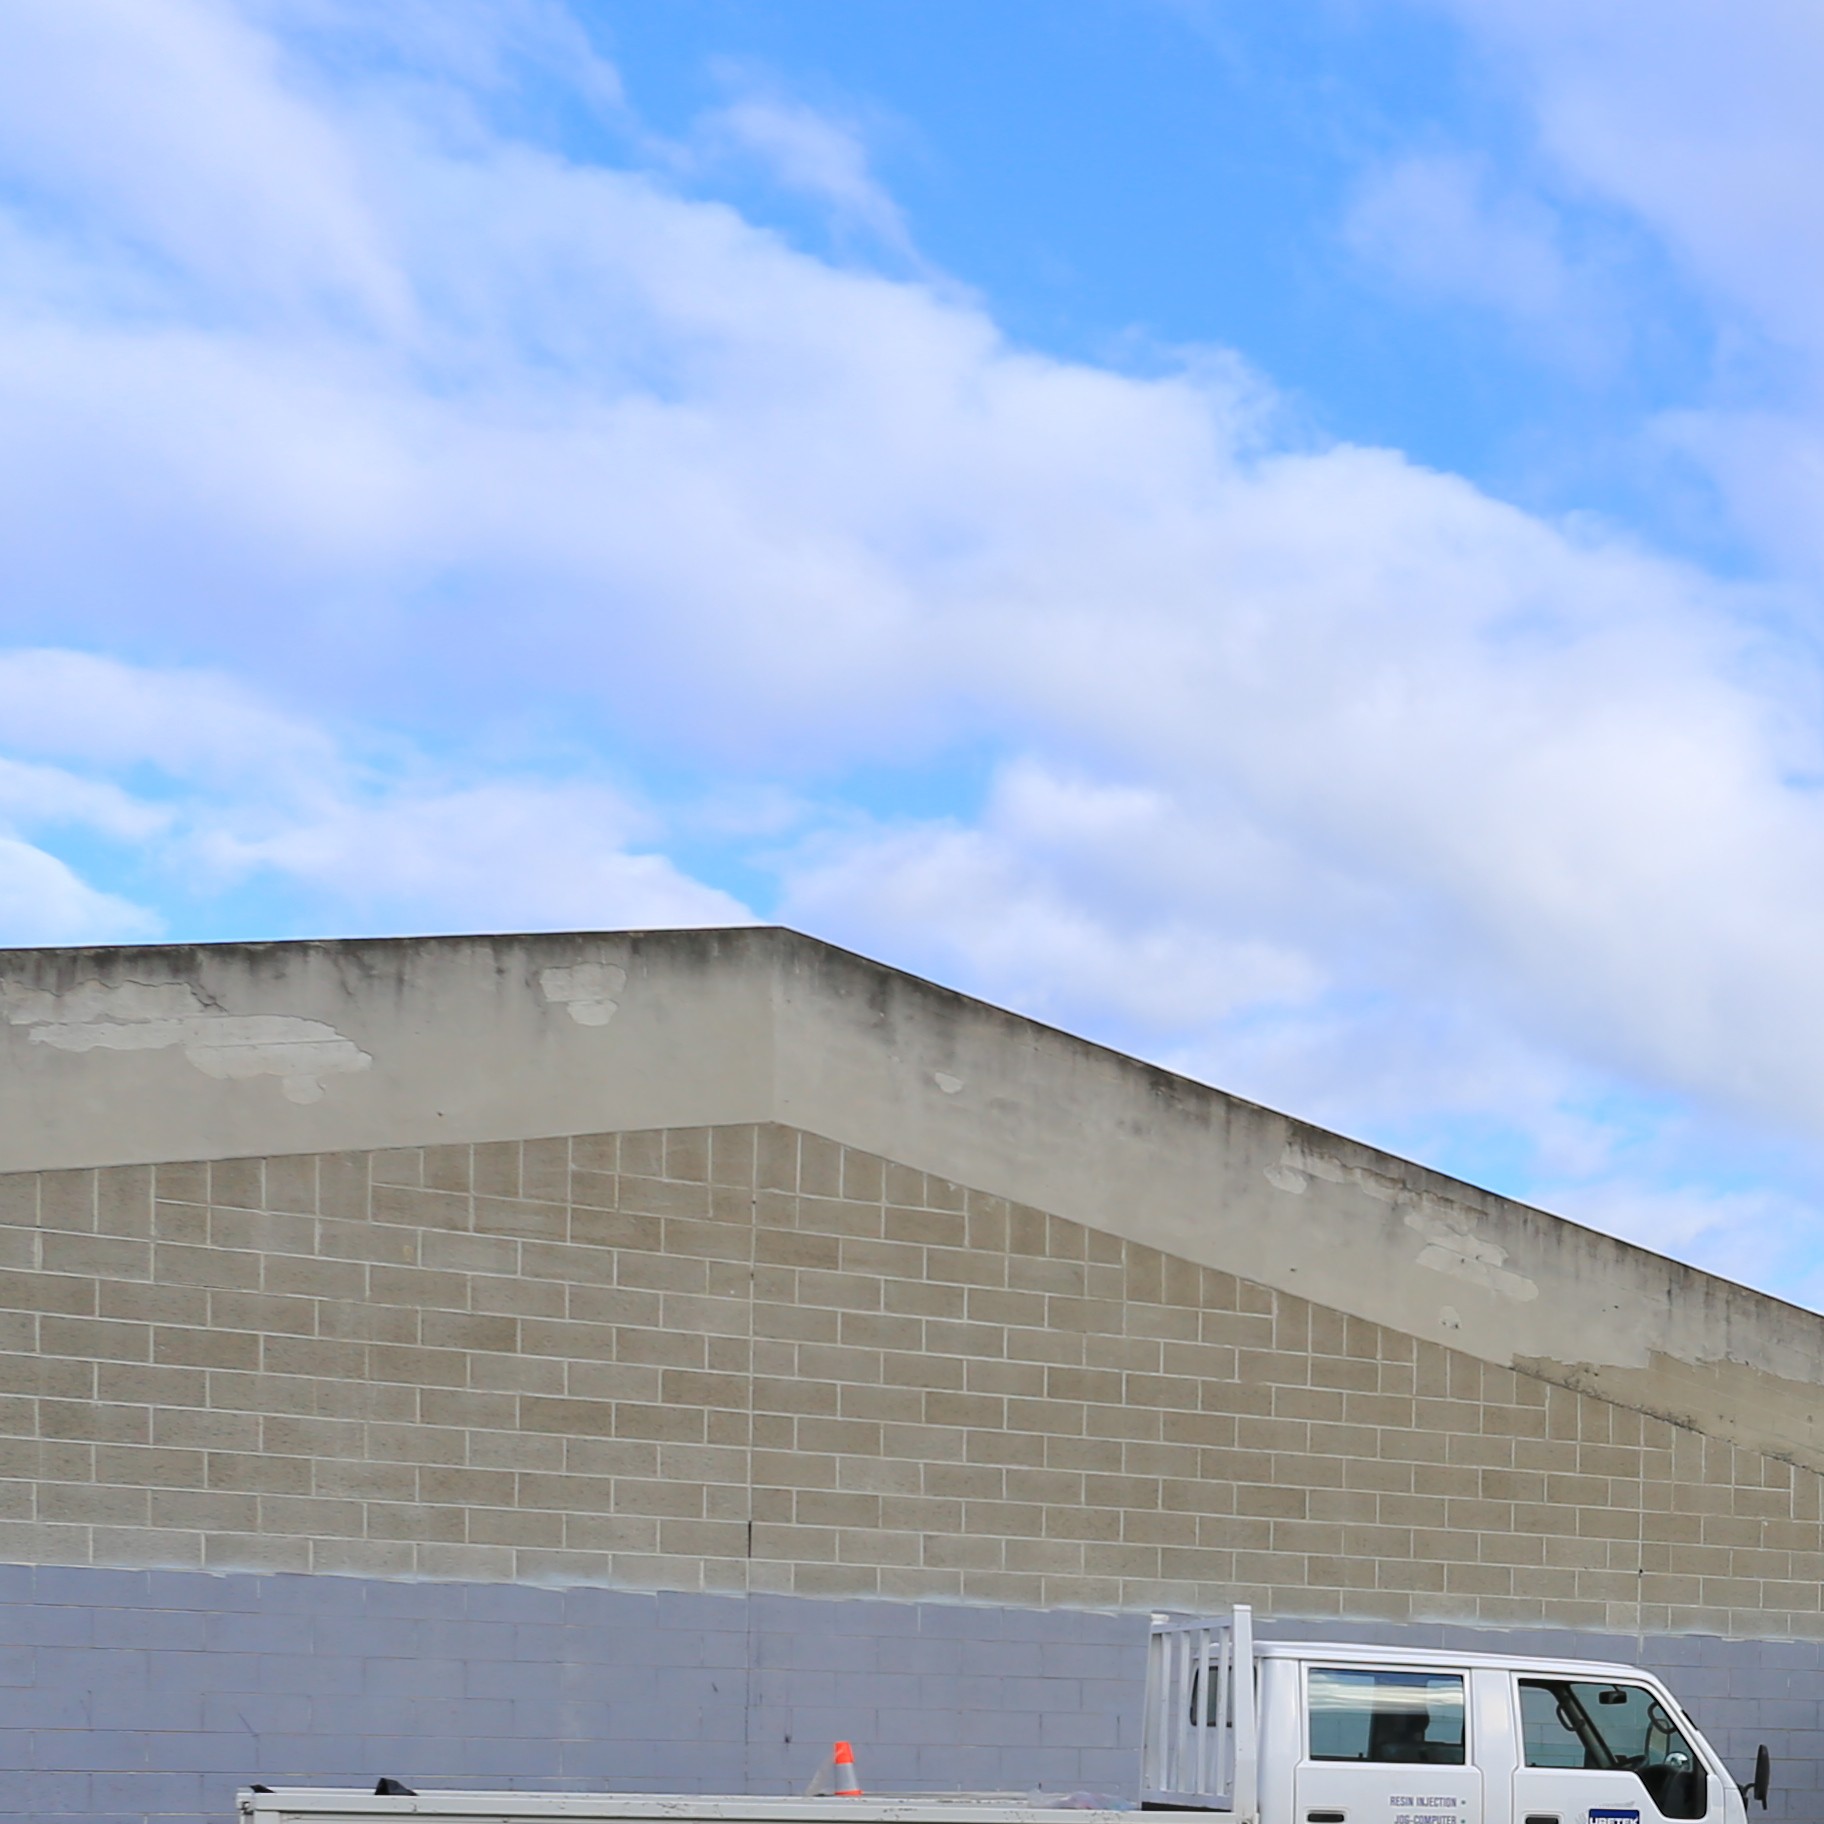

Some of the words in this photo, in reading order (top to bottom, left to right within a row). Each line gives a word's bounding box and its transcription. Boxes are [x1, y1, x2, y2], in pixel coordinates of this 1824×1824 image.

[1390, 1796, 1414, 1807] RESIN
[1416, 1797, 1457, 1807] INJECTION
[1394, 1815, 1457, 1824] JOG-COMPUTER
